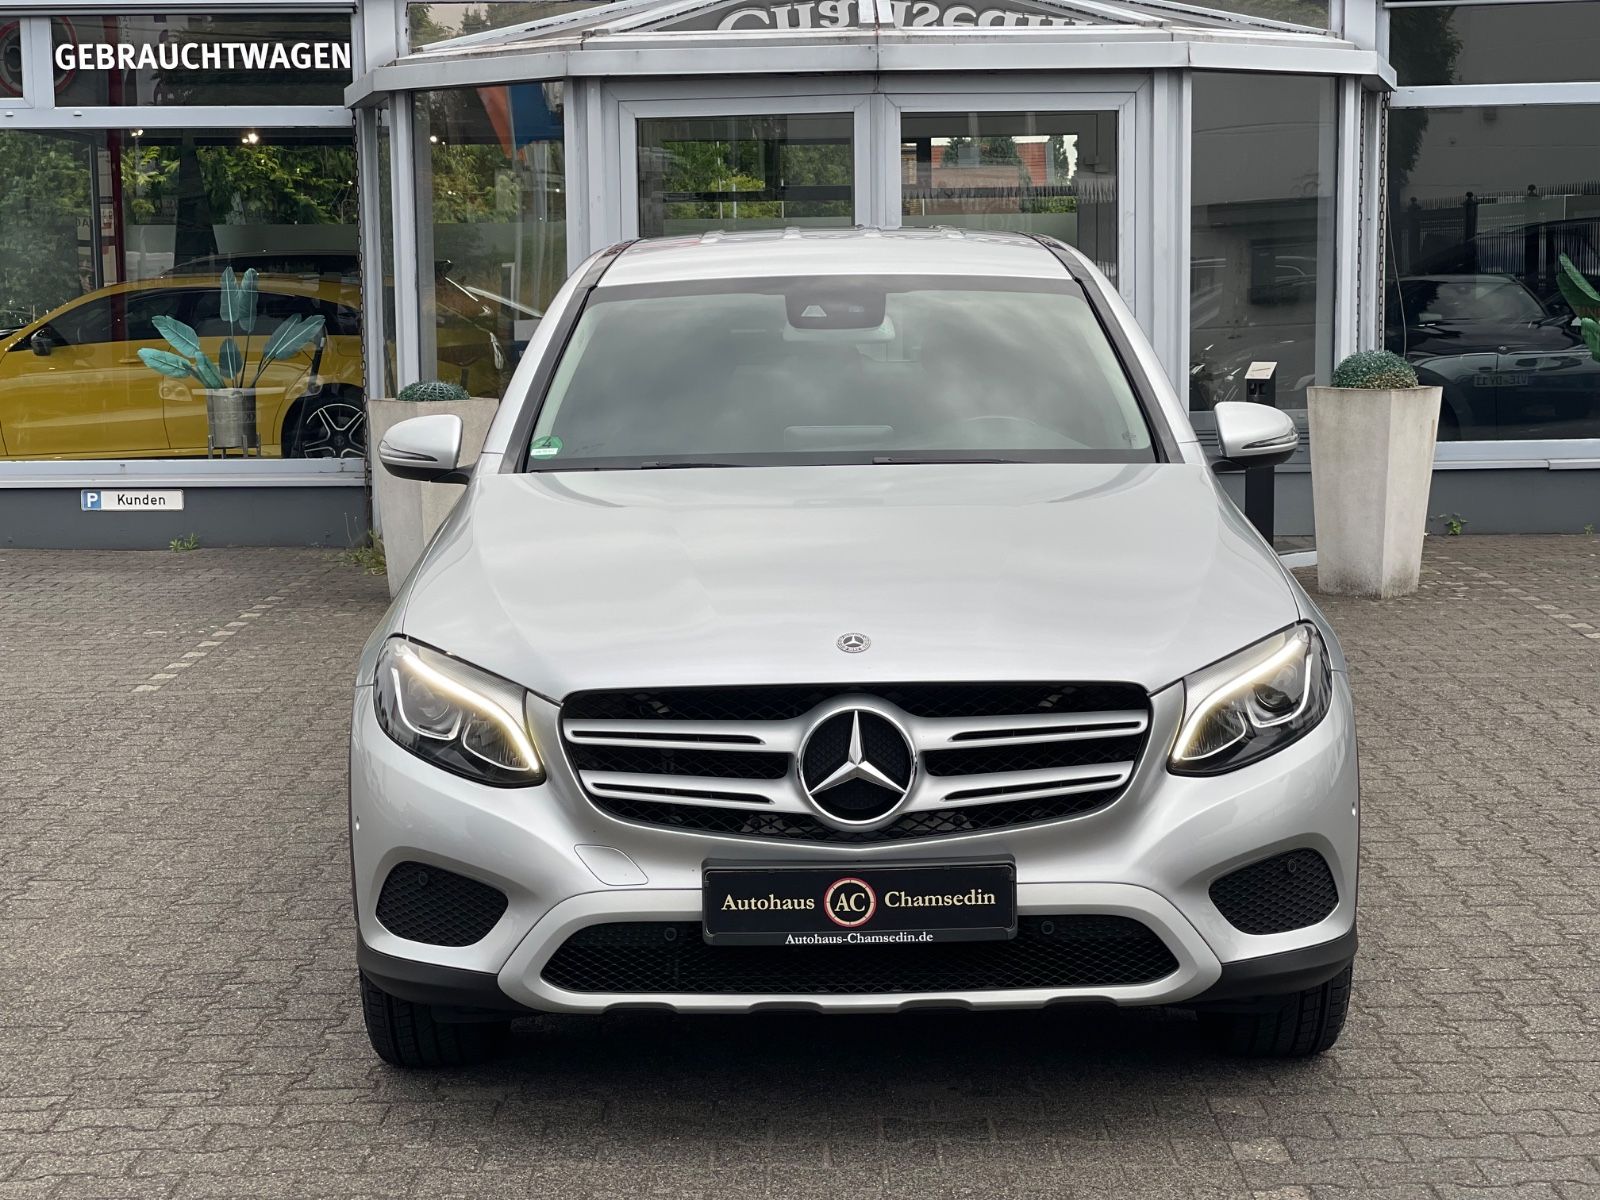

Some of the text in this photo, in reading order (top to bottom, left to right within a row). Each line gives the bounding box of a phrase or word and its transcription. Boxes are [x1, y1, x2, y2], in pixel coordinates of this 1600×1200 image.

[55, 42, 351, 70] GEBRAUCHTWAGEN
[542, 437, 552, 448] 4
[86, 492, 166, 508] P Kunden
[721, 889, 996, 912] Autohaus AC Chamsedin
[785, 931, 934, 945] Autohaus-Chamsedin.de
